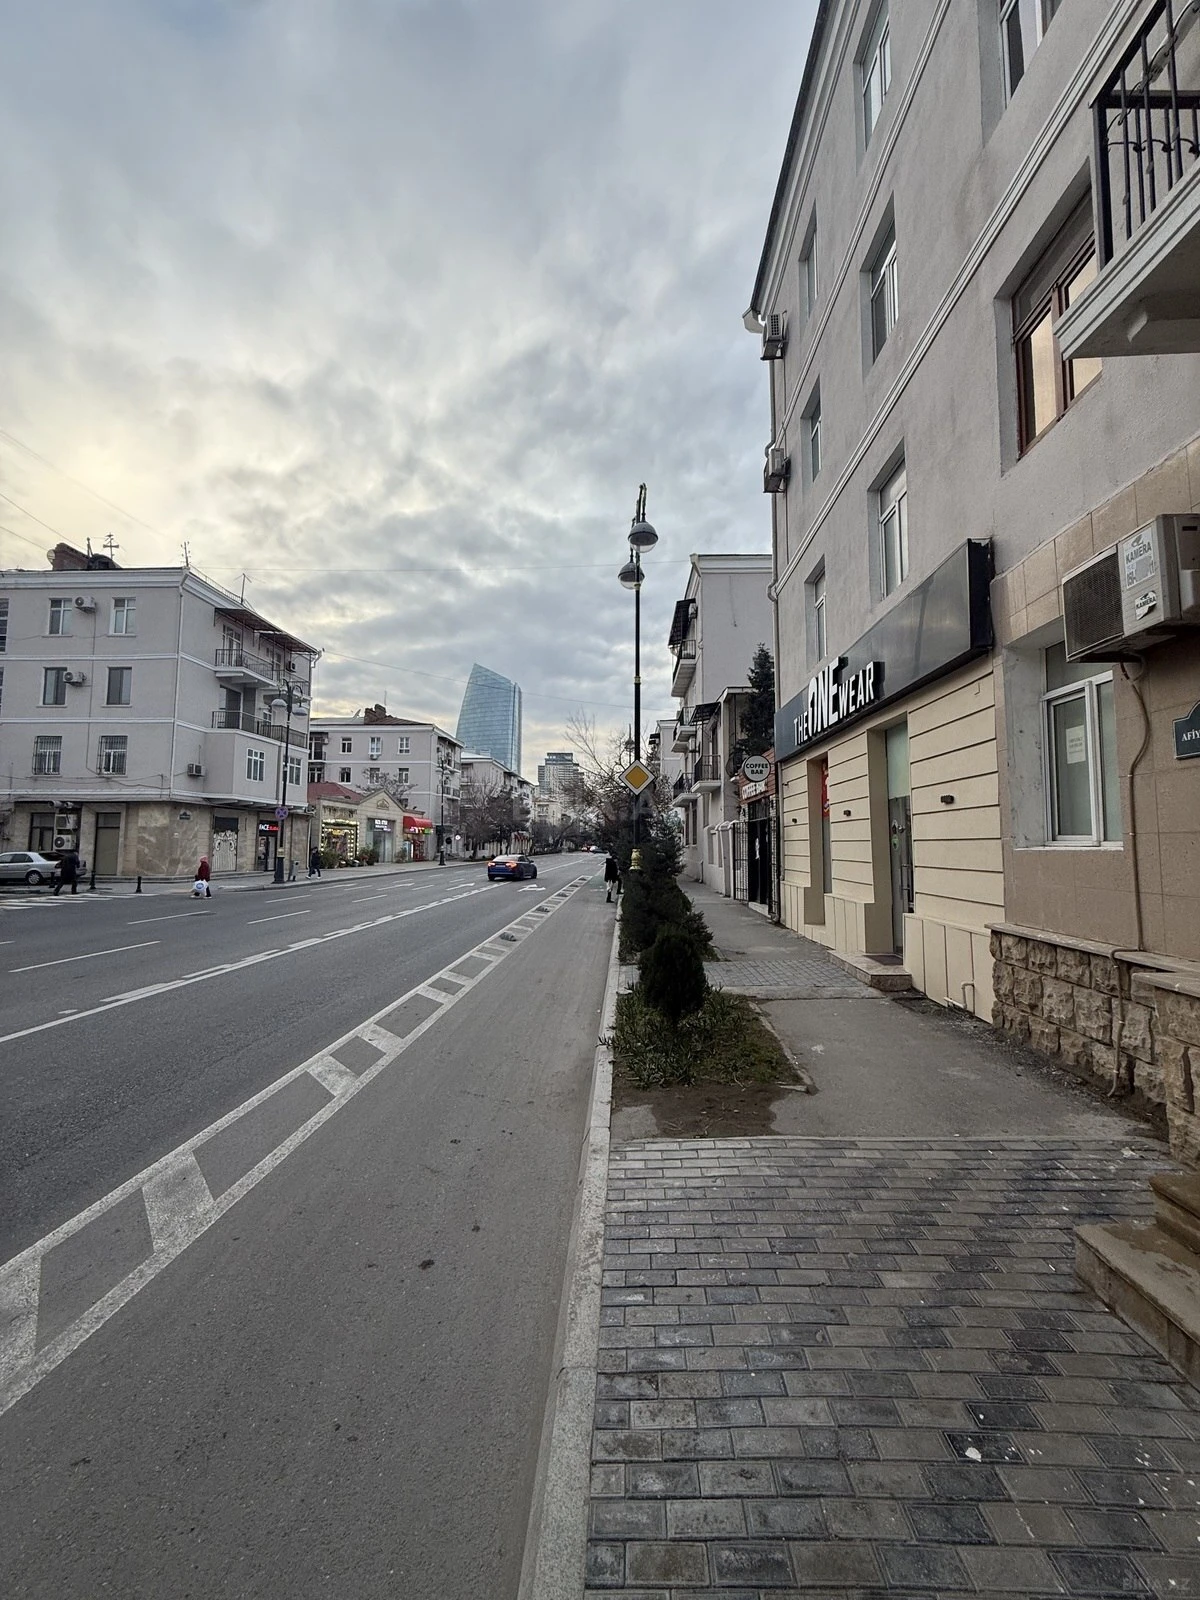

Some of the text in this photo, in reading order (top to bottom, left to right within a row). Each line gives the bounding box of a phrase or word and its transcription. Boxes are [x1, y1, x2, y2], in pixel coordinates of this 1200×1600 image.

[1126, 541, 1152, 564] KAMERA
[1136, 596, 1157, 609] KAMERA
[793, 656, 874, 746] THE ONE WEAR
